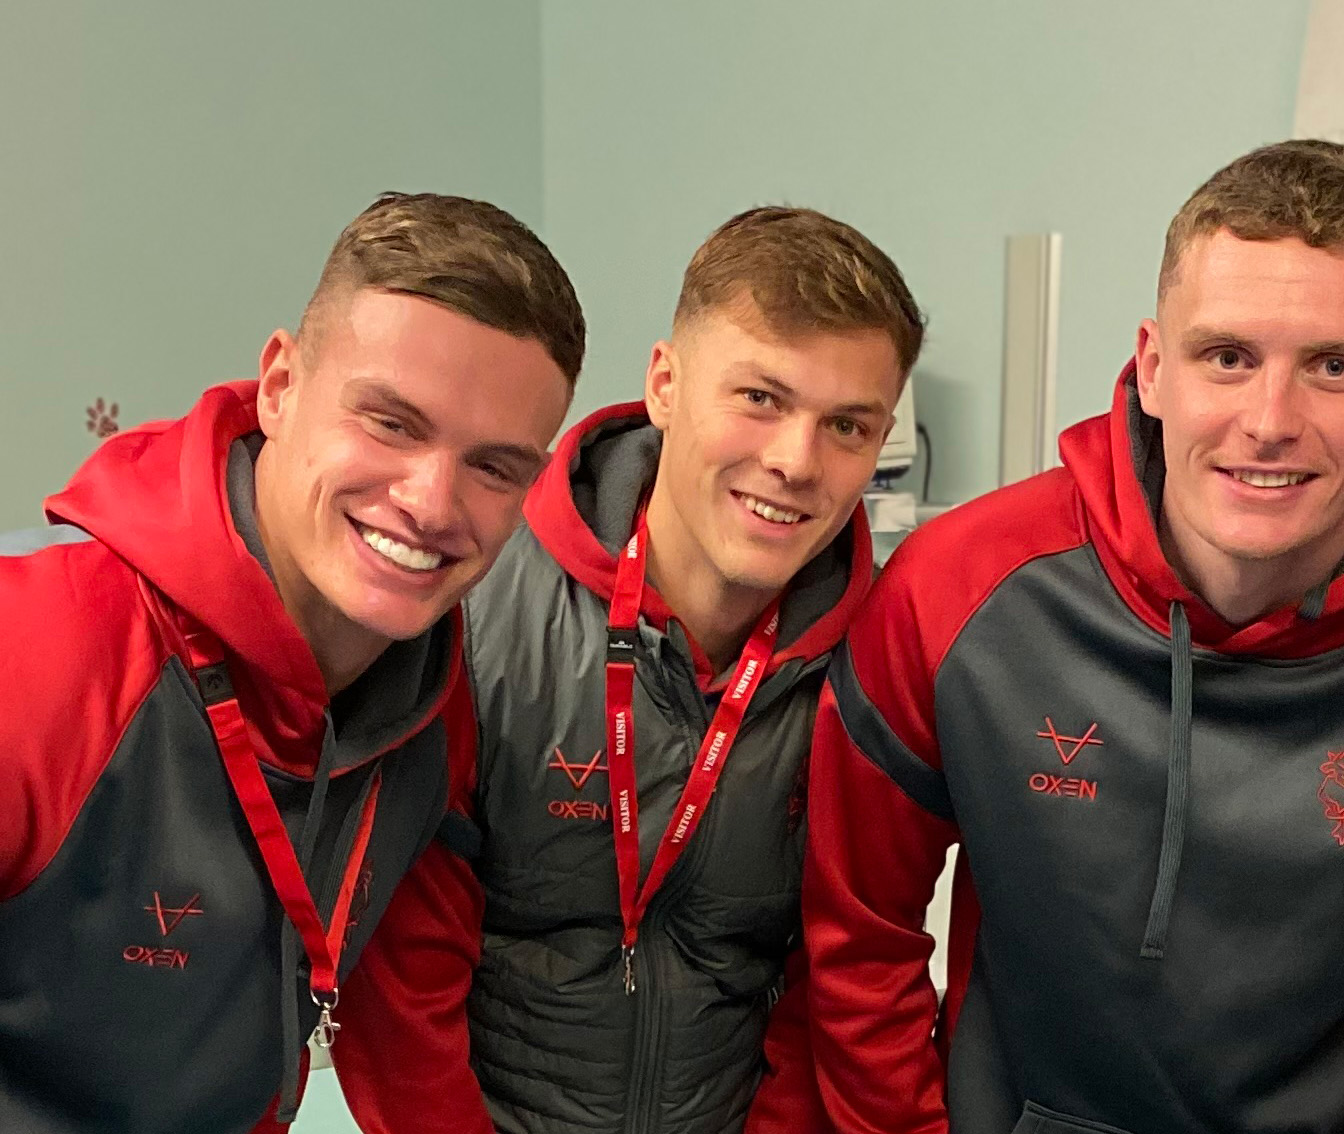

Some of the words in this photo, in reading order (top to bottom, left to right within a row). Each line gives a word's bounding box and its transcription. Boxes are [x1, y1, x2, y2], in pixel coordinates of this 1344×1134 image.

[731, 659, 759, 699] VISITOR
[615, 711, 626, 755] VISITOR
[702, 730, 728, 772] VISITOR
[1028, 772, 1097, 801] OXEN
[548, 800, 608, 821] OXEN
[619, 789, 631, 834] VISITOR
[670, 803, 697, 843] VISITOR
[123, 945, 190, 971] OXEN
